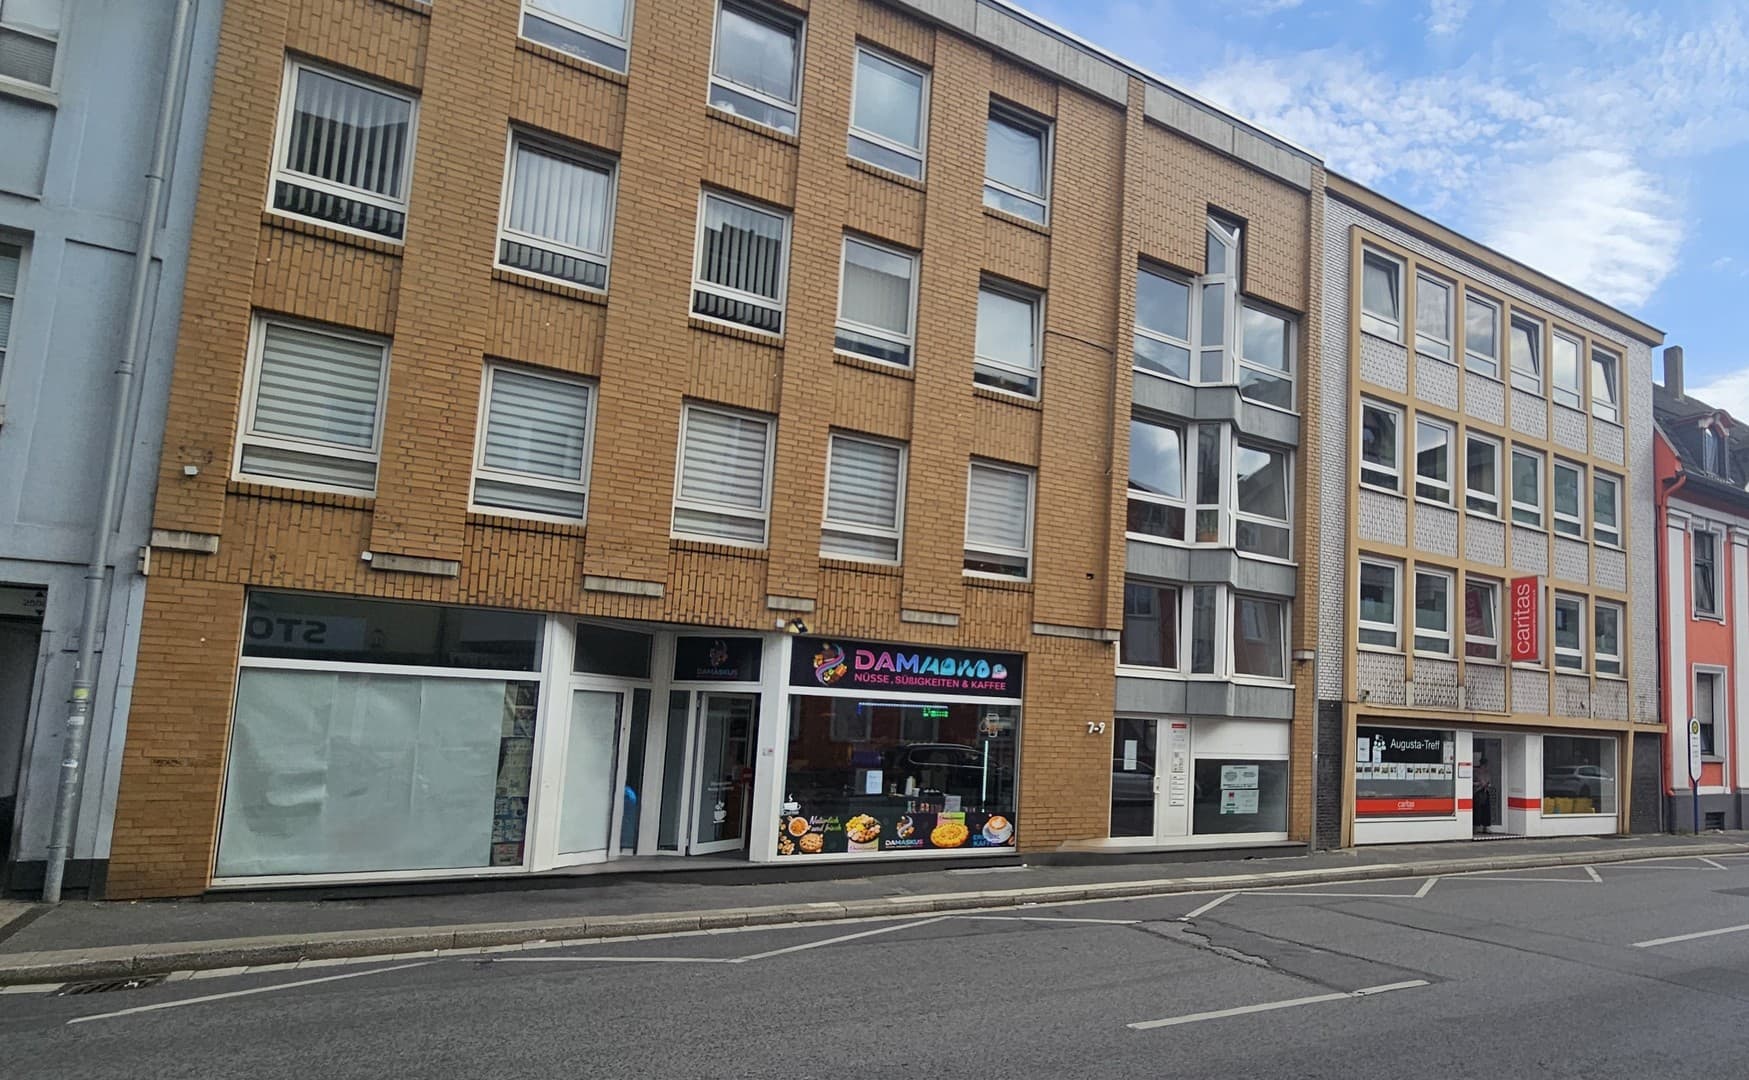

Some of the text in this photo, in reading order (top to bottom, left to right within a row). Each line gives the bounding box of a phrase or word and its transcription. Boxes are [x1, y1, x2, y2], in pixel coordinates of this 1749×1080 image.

[1513, 583, 1530, 654] caritas
[855, 649, 1007, 679] DAMA
[961, 680, 969, 688] &
[971, 681, 1007, 690] KAFFEE
[1390, 738, 1441, 751] Augusta-Treff
